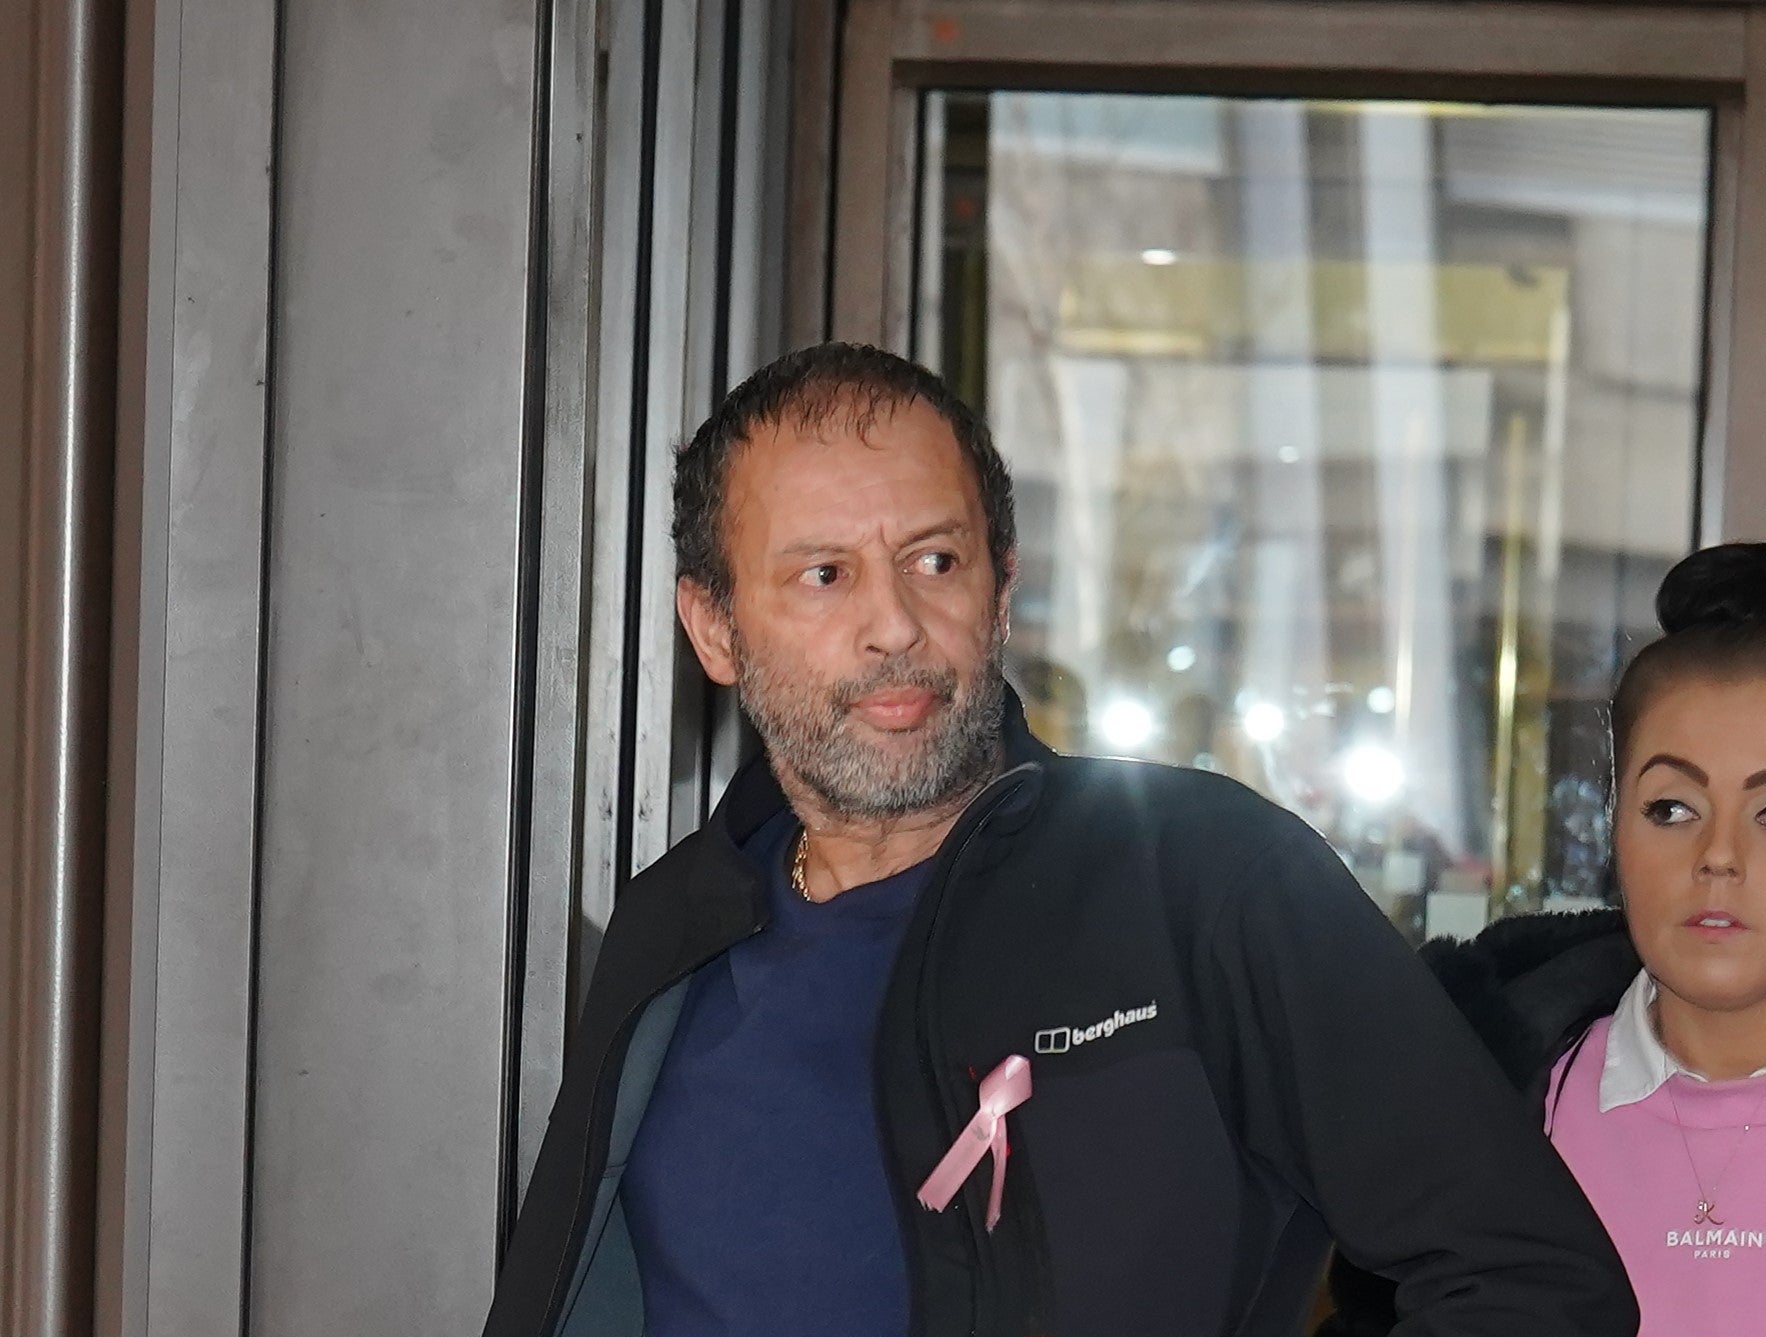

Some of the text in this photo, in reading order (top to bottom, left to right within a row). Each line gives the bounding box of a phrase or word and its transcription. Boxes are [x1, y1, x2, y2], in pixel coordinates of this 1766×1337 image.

[1071, 1003, 1157, 1046] berghaus
[1666, 1230, 1763, 1247] BALMAIN
[1694, 1250, 1731, 1259] PARIS
